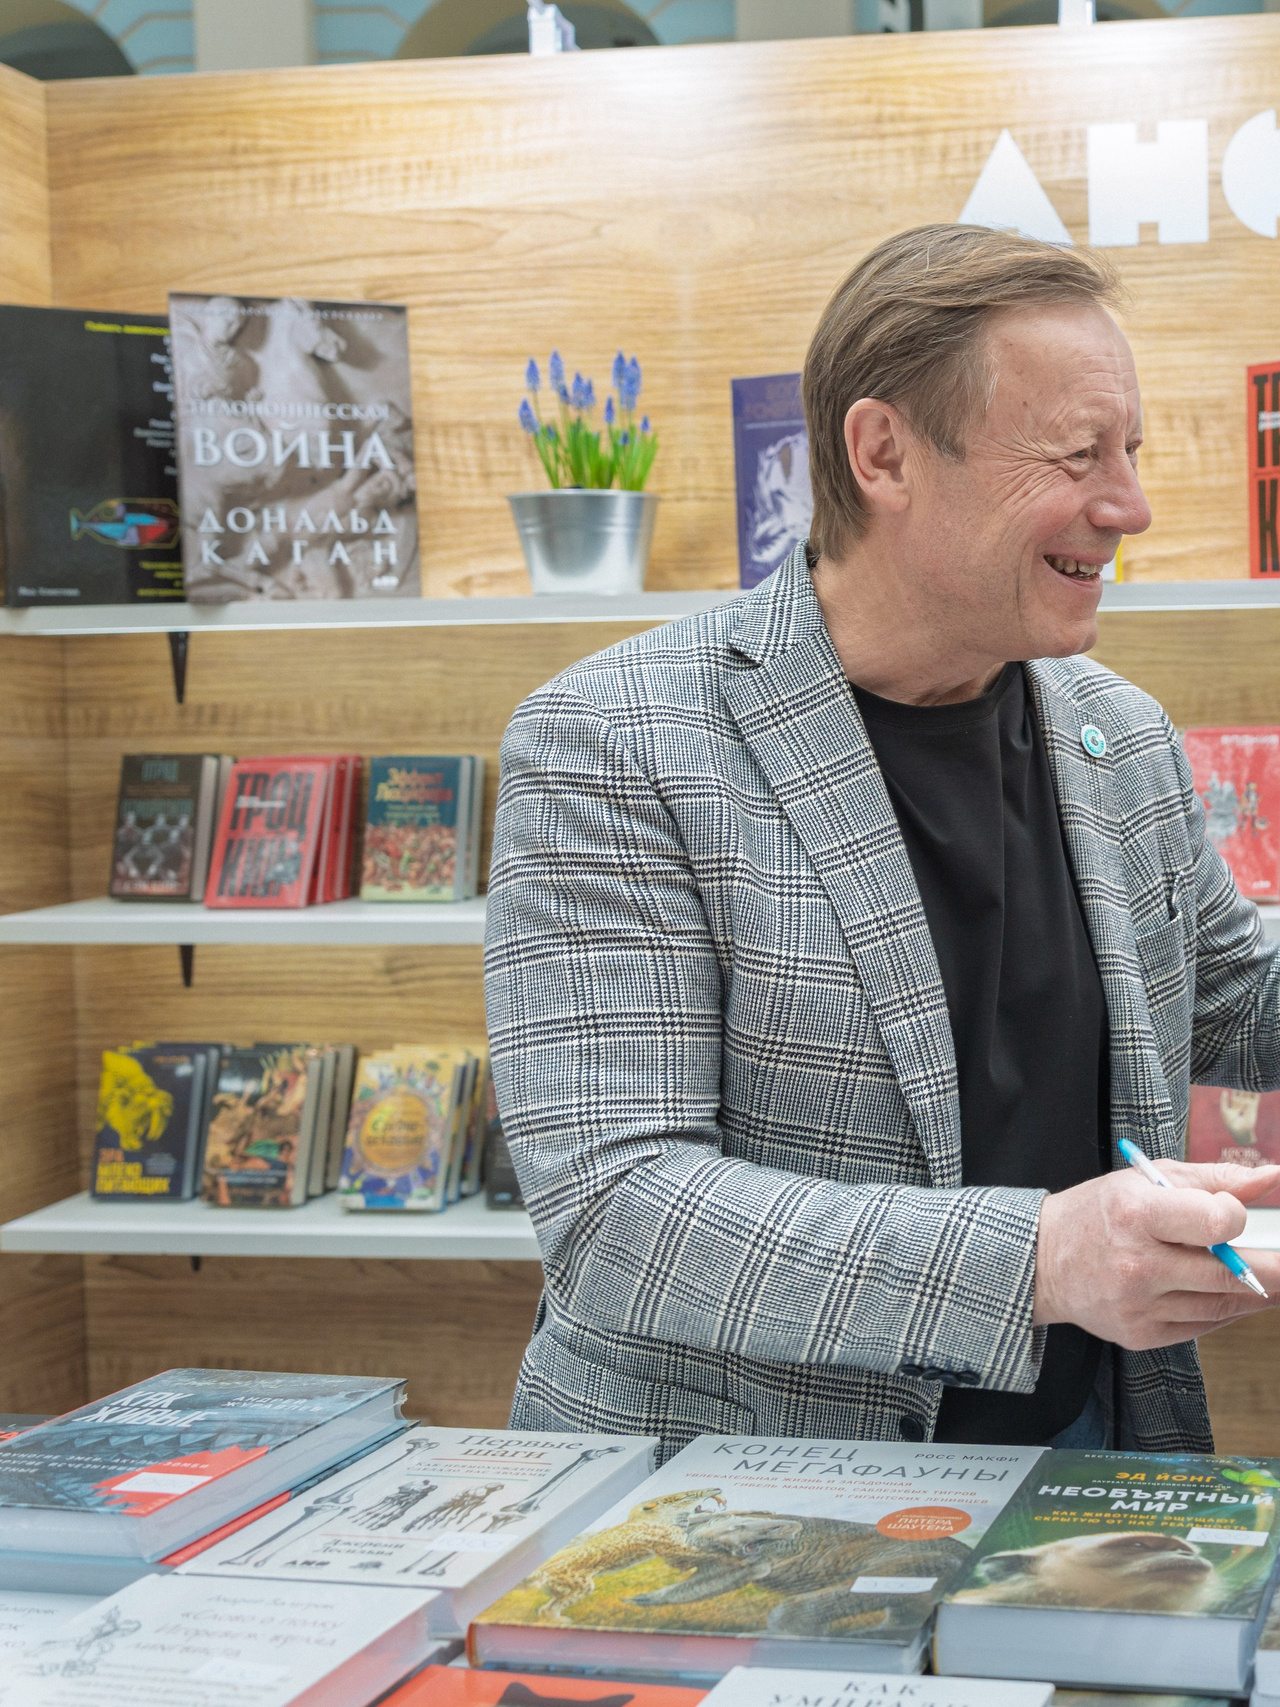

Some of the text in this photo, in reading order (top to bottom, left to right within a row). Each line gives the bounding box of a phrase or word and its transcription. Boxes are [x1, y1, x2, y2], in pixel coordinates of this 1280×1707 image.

[192, 421, 396, 470] ВОЙНА
[198, 505, 397, 535] ДОНАЛЬД
[201, 539, 398, 566] КАГАН
[109, 1391, 195, 1408] КАК
[232, 1396, 307, 1404] АНДРЕЙ
[72, 1406, 220, 1428] ЖИВЫЕ
[455, 1435, 584, 1450] Первые
[0, 1452, 60, 1461] ВУНОГИЕ
[461, 1448, 549, 1460] шаги
[713, 1442, 859, 1462] КОНЕЦ
[914, 1453, 1019, 1463] РОСС МАКФИ
[1084, 1454, 1151, 1462] БЕСТСЕЛЛЕР
[733, 1460, 1010, 1482] МЕГАФАУНЫ
[1115, 1471, 1218, 1483] ЭД ЙОНГ
[684, 1472, 779, 1482] УВЛЕКАТЕЛЬНАЯ
[782, 1477, 822, 1485] ЖИЗНЬ
[840, 1480, 913, 1488] ЗАГАДОЧНАЯ
[782, 1484, 848, 1492] МАМОНТОВ,
[852, 1487, 929, 1495] САБЛЕЗУБЫХ
[934, 1489, 978, 1497] ТИГРОВ
[1037, 1485, 1274, 1506] НЕОБЪЯТНЫЙ
[847, 1494, 922, 1502] ГИГАНТСКИХ
[925, 1496, 990, 1505] ЛЕНИВЦЕВ
[1110, 1500, 1189, 1513] МИР
[897, 1517, 953, 1526] ПИТЕРА
[1034, 1515, 1101, 1525] СКРЫТУЮ
[1160, 1521, 1248, 1531] РЕАЛЬНОСТЬ
[1082, 1511, 1157, 1521] ЖИВОТНЫЕ
[1163, 1515, 1236, 1525] ОЩУЩАЮТ
[886, 1522, 954, 1532] ШАУТЕНА
[843, 1681, 923, 1696] КАК
